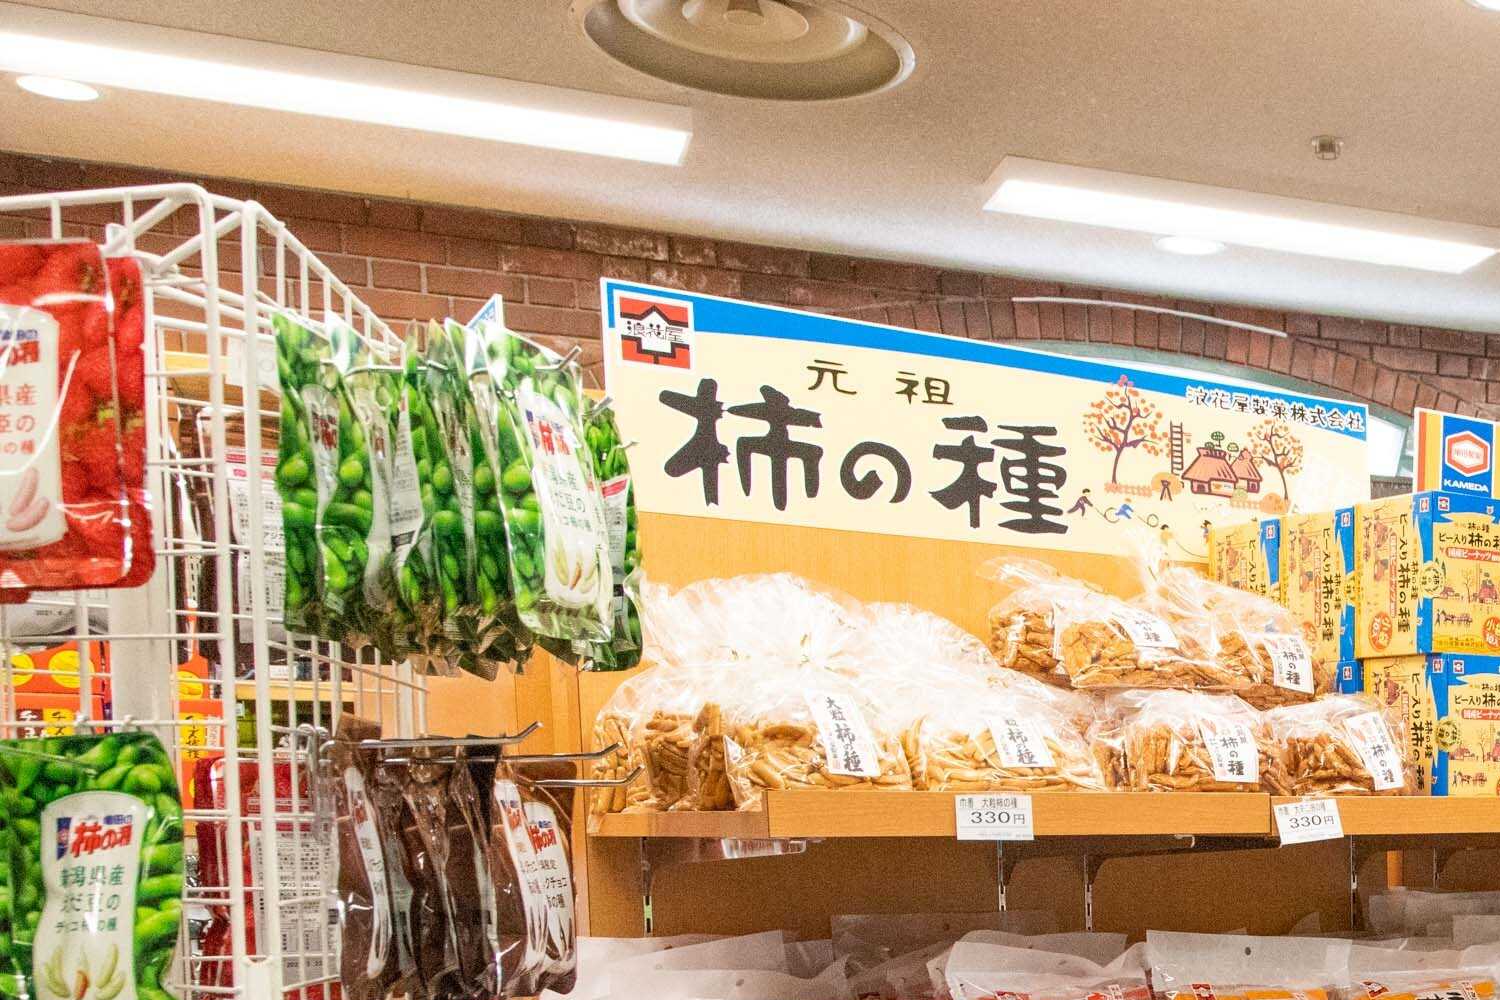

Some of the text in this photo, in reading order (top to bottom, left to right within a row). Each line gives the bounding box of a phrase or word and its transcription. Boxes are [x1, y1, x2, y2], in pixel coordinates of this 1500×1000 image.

[627, 321, 684, 342] 浪花屋
[806, 359, 953, 405] 元祖
[1187, 386, 1366, 432] 浪花屋製菓株式会社
[659, 378, 1069, 535] 柿の種
[1443, 478, 1489, 493] KAMEDA
[1220, 737, 1245, 777] 柿の種
[970, 811, 1026, 825] 330円
[1289, 814, 1335, 829] 330円
[71, 821, 132, 857] 柿の種
